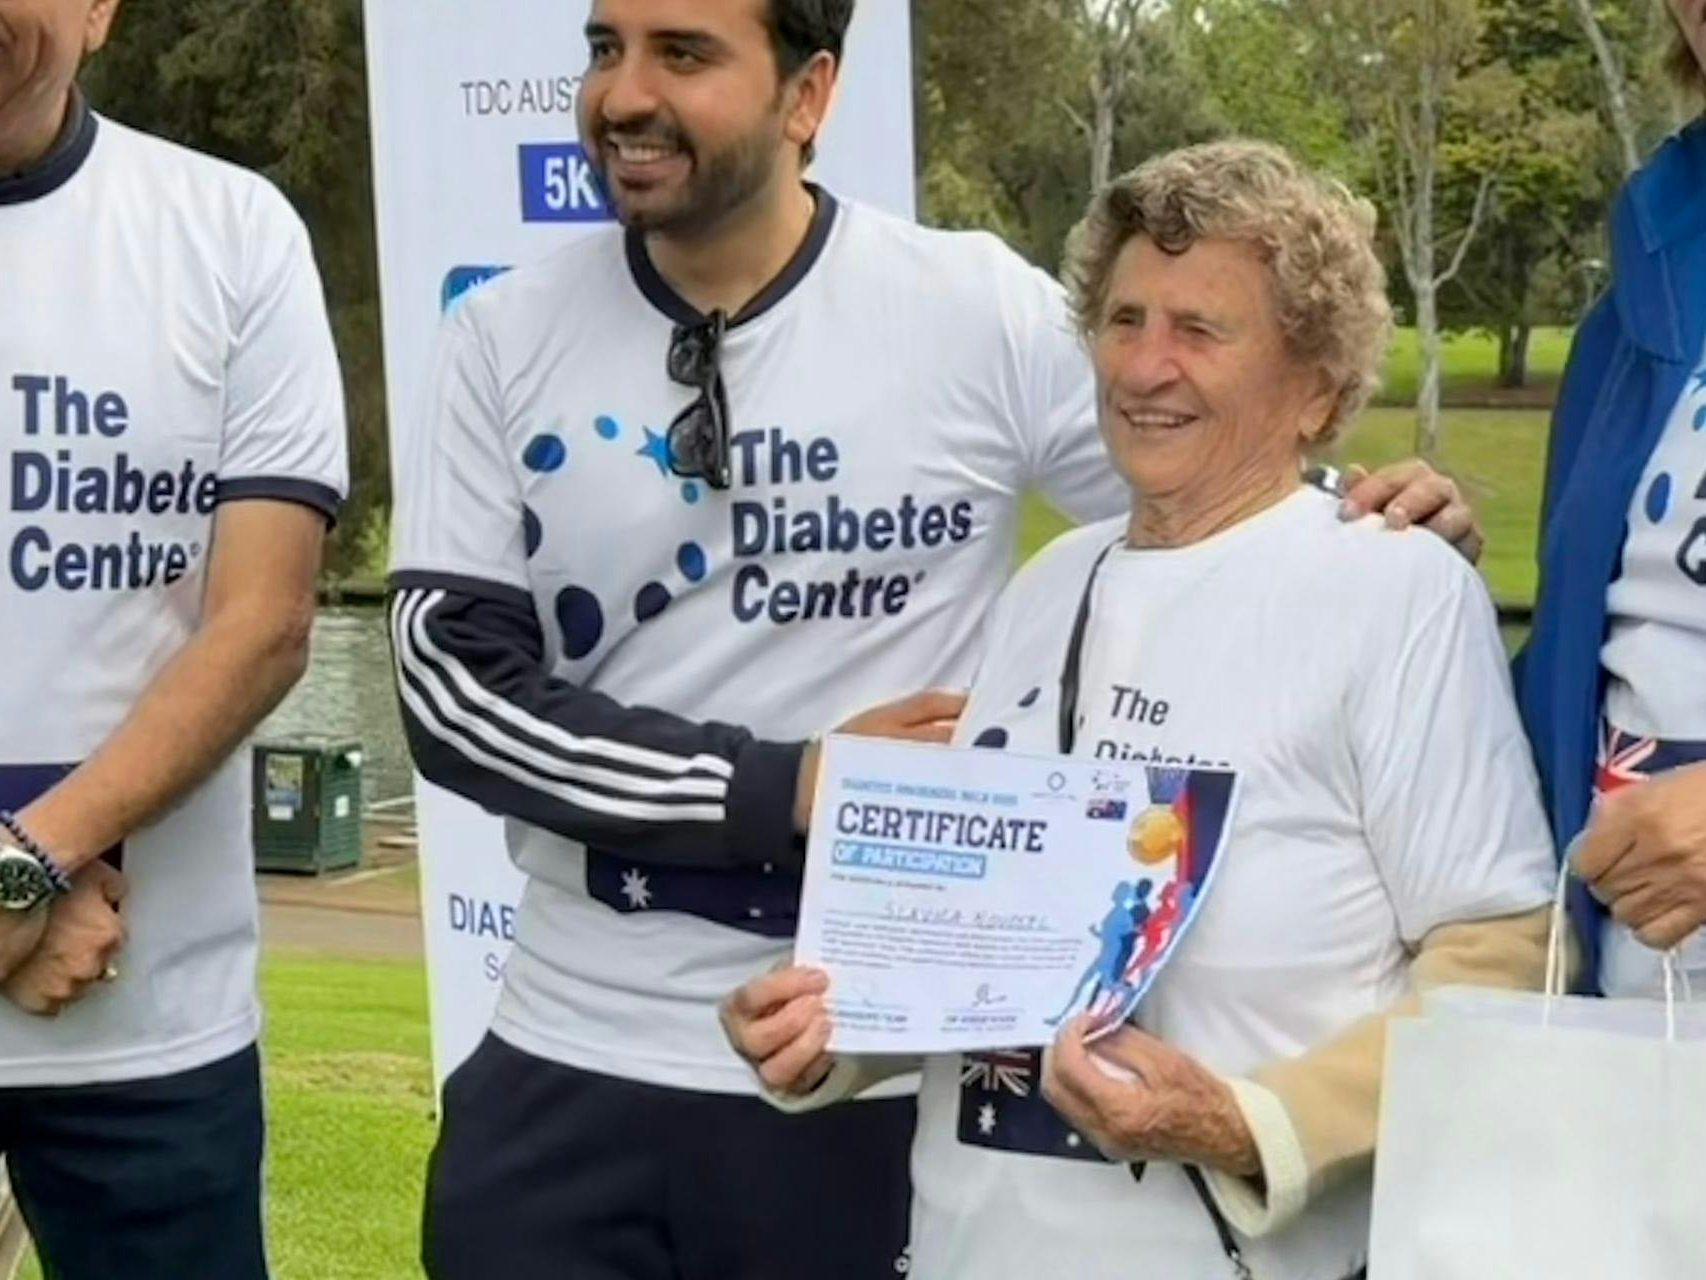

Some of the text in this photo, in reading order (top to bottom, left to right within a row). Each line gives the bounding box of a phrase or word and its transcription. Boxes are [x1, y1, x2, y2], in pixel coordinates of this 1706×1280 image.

[460, 79, 512, 115] TDC
[10, 375, 130, 438] The
[10, 449, 219, 515] Diabete
[730, 426, 839, 487] The
[731, 493, 973, 558] Diabetes
[1111, 684, 1170, 726] The
[836, 801, 1048, 853] CERTIFICATE
